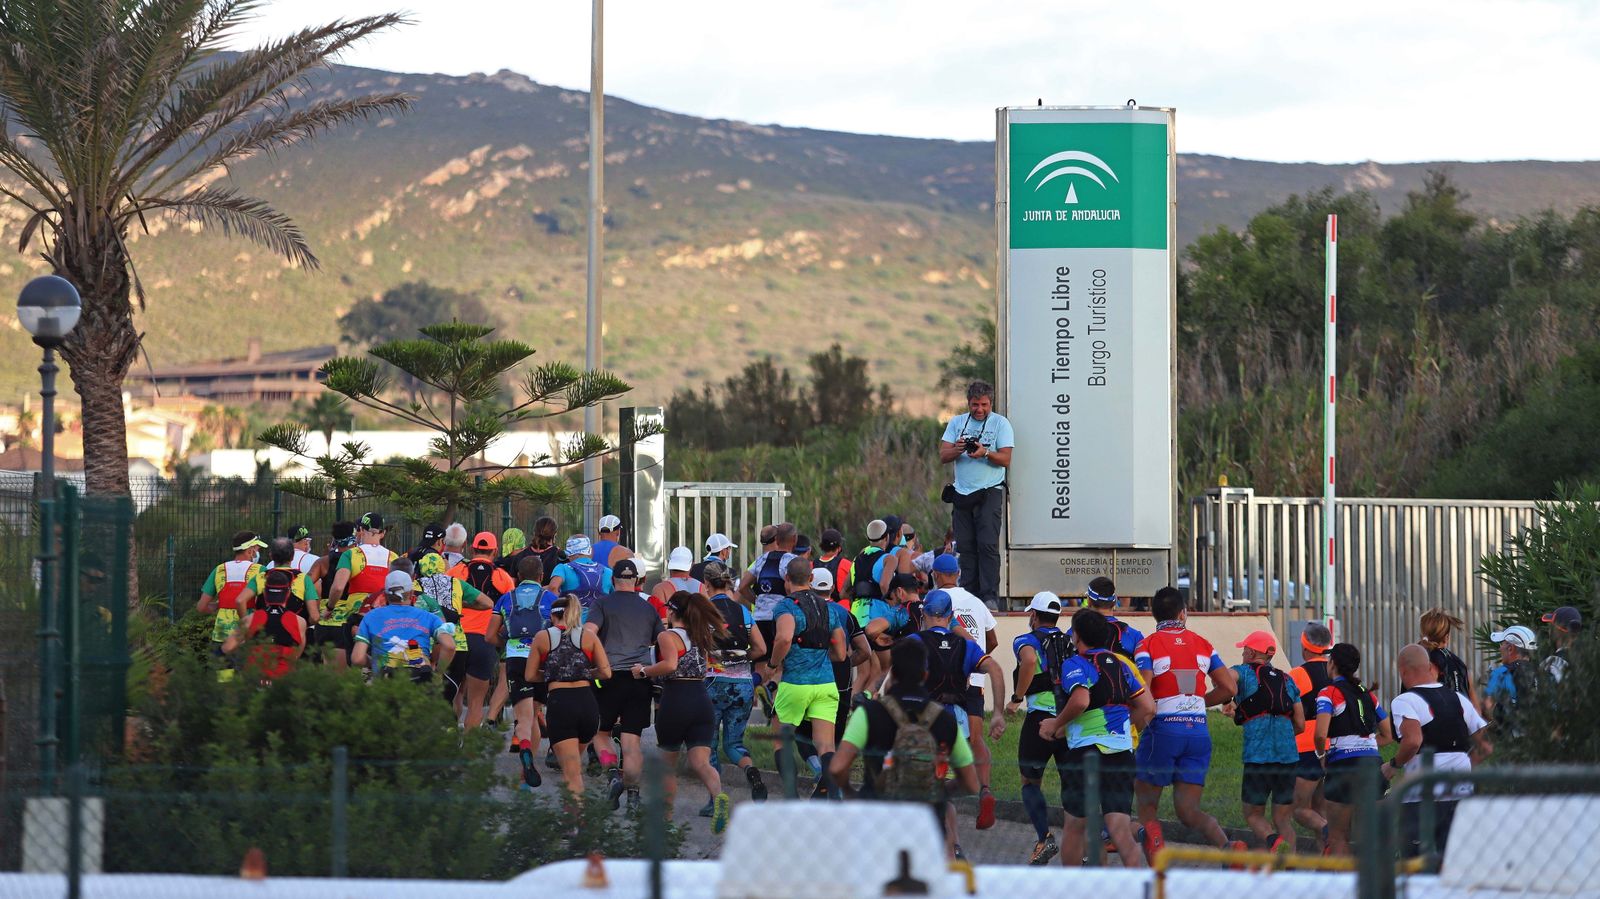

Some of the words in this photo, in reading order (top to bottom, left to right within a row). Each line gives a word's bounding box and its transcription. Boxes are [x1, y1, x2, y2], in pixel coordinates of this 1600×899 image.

[1023, 210, 1052, 221] JUNTA
[1055, 210, 1068, 221] DE
[1072, 209, 1121, 221] ANDALUCIA
[1052, 267, 1070, 310] Libre
[1088, 269, 1106, 335] Turístico
[1052, 318, 1074, 383] Tiempo
[1088, 341, 1111, 385] Burgo
[1052, 394, 1070, 414] de
[1052, 421, 1070, 519] Residencia
[1065, 567, 1101, 575] EMPRESA
[1102, 567, 1108, 575] Y
[1109, 567, 1150, 575] COMERCIO
